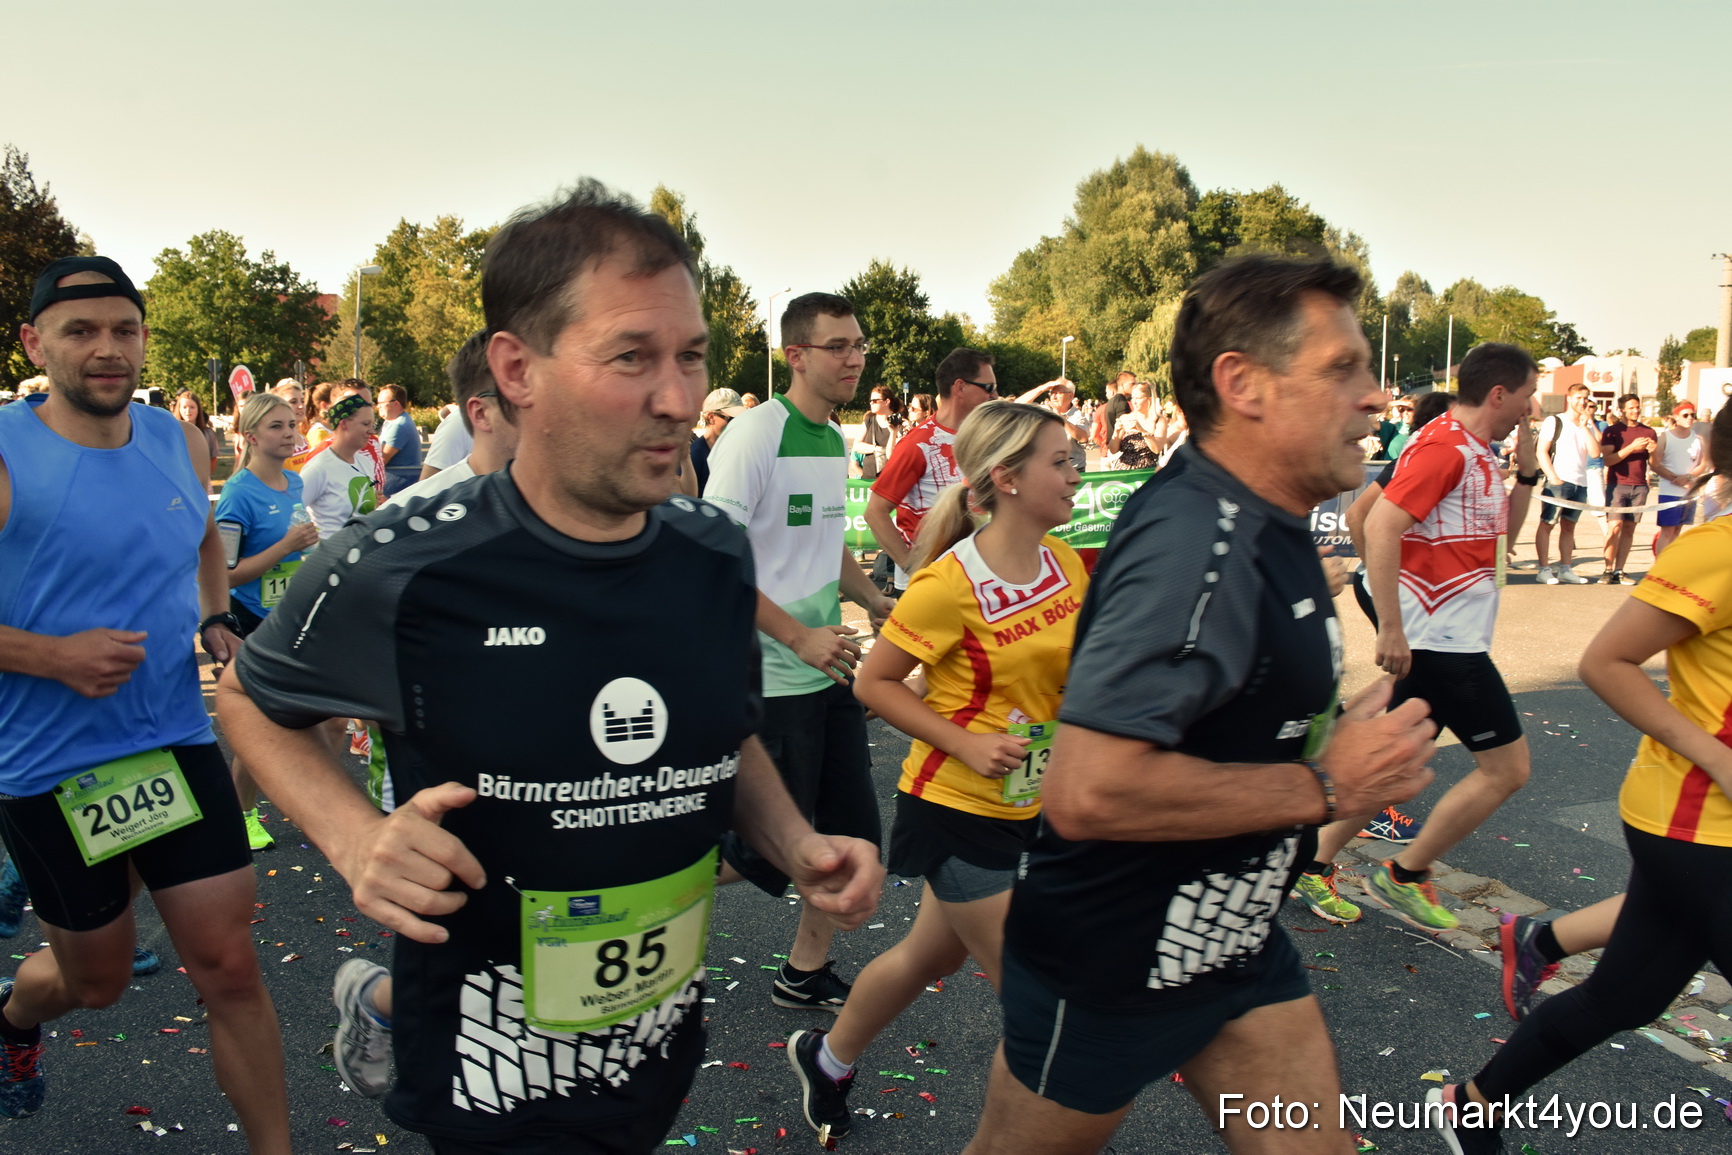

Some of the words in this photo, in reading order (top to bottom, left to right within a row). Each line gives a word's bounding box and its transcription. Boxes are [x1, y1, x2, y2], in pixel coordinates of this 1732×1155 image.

[1072, 480, 1144, 520] AO
[484, 627, 546, 646] JAKO
[993, 617, 1042, 648] MAX
[1041, 595, 1082, 627] BÖGL
[82, 777, 175, 837] 2049
[110, 818, 147, 838] Weigert
[149, 810, 169, 824] Jörg
[551, 792, 707, 829] SCHOTTERWERKE
[594, 926, 667, 988] 85
[580, 988, 632, 1007] Weber
